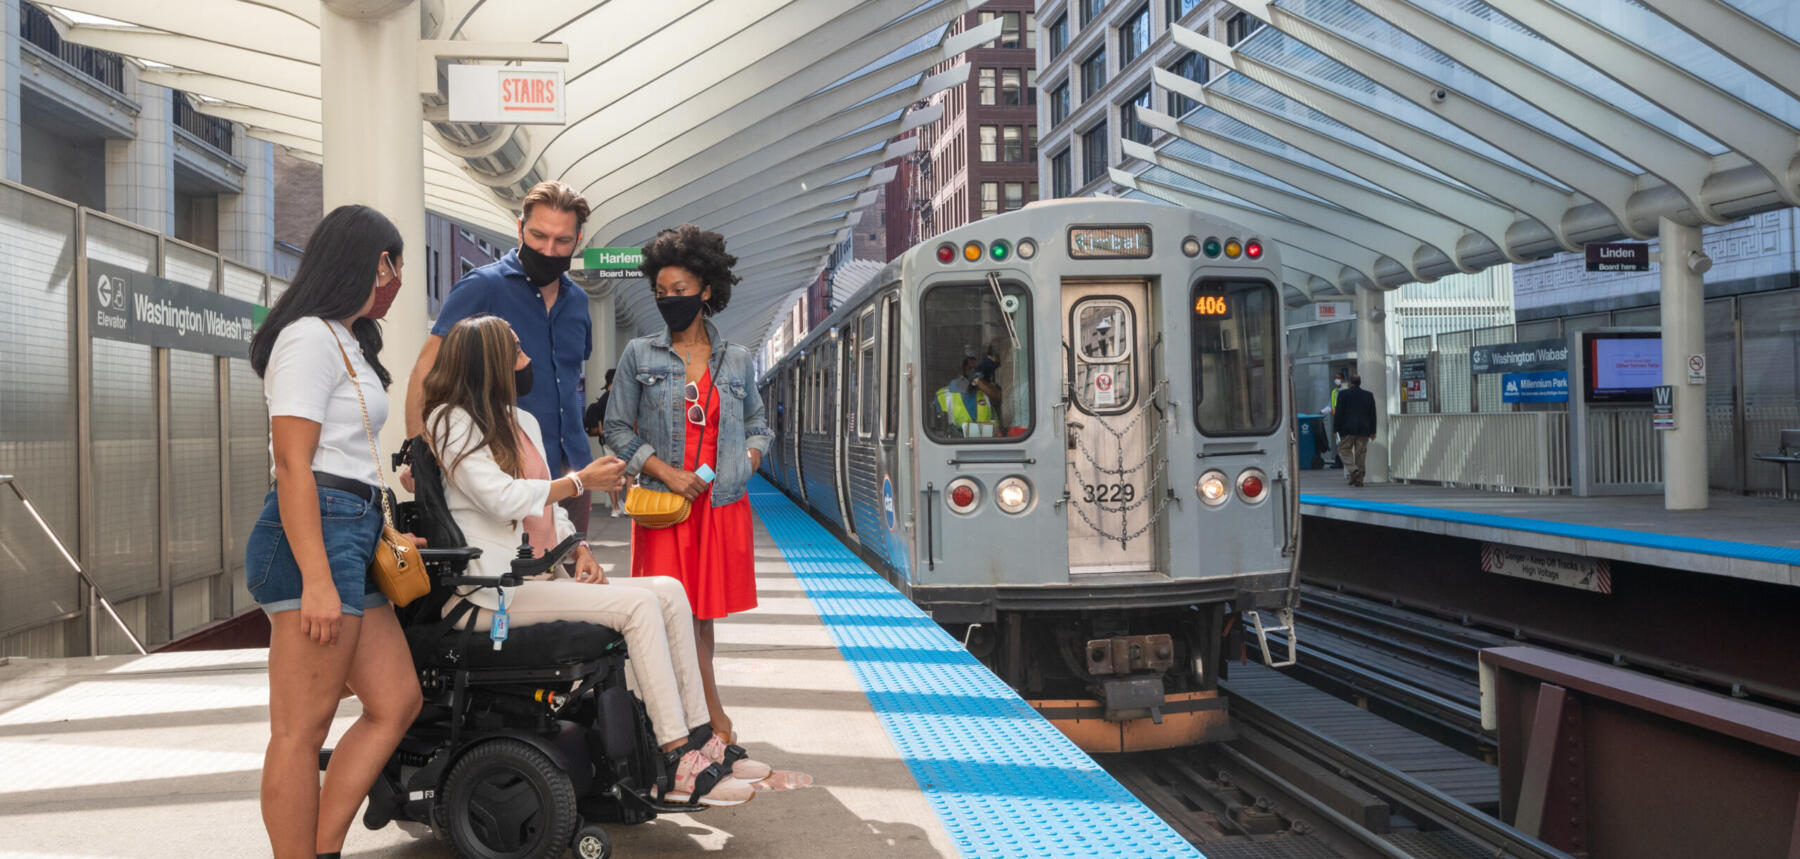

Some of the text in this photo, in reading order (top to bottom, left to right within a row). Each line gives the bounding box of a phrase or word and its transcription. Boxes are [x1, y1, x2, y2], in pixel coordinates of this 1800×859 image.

[502, 78, 555, 103] STAIRS
[600, 252, 643, 264] Harlem
[1600, 247, 1636, 258] Linden
[600, 270, 643, 278] Board here
[1598, 263, 1637, 271] Board here
[1195, 296, 1227, 315] 406
[97, 311, 127, 329] Elevator
[134, 292, 242, 340] Washington/Wabash
[1520, 377, 1568, 389] Millennium Park
[1656, 387, 1670, 405] W
[1083, 483, 1135, 503] 3229
[884, 492, 893, 513] cta
[1523, 566, 1560, 581] High Voltage
